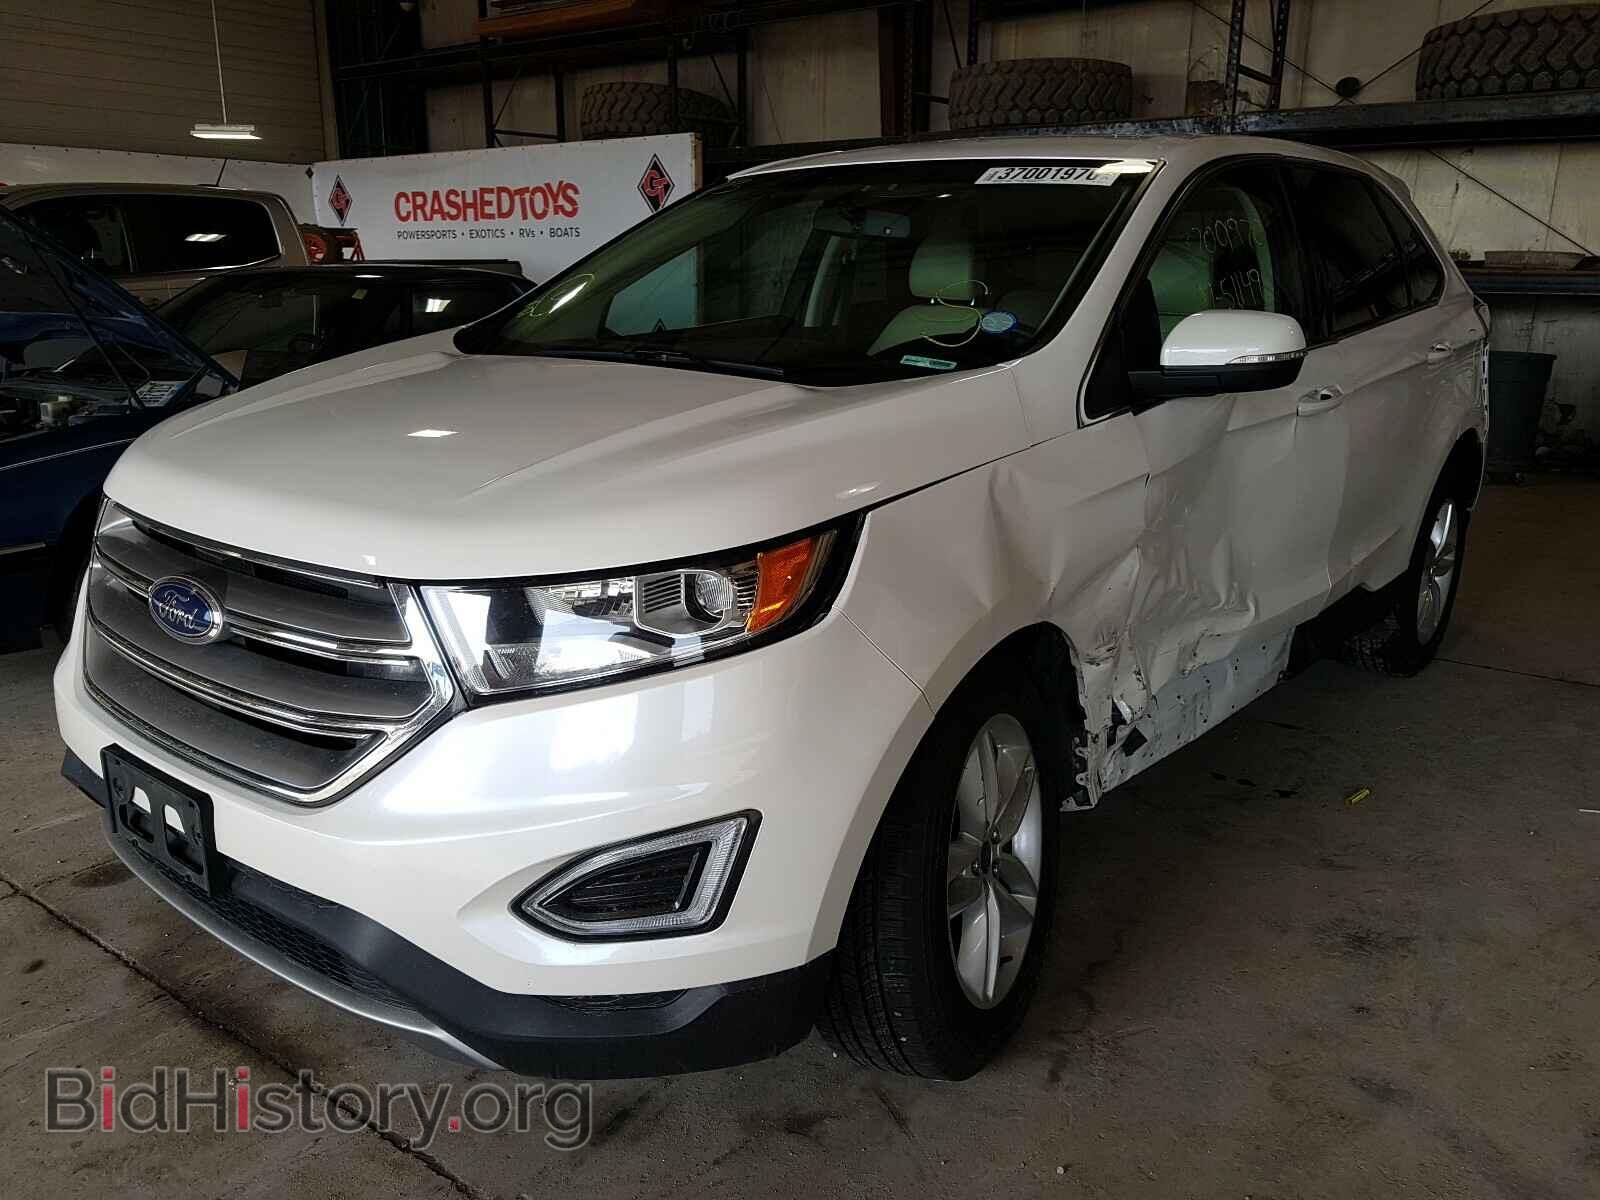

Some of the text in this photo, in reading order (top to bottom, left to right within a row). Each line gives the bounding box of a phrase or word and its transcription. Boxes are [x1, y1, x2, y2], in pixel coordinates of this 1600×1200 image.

[394, 180, 580, 222] CRASHEDTOYS
[396, 227, 581, 240] POWERSPORTS EXOTICS RVs BOATS
[158, 589, 200, 630] Ford
